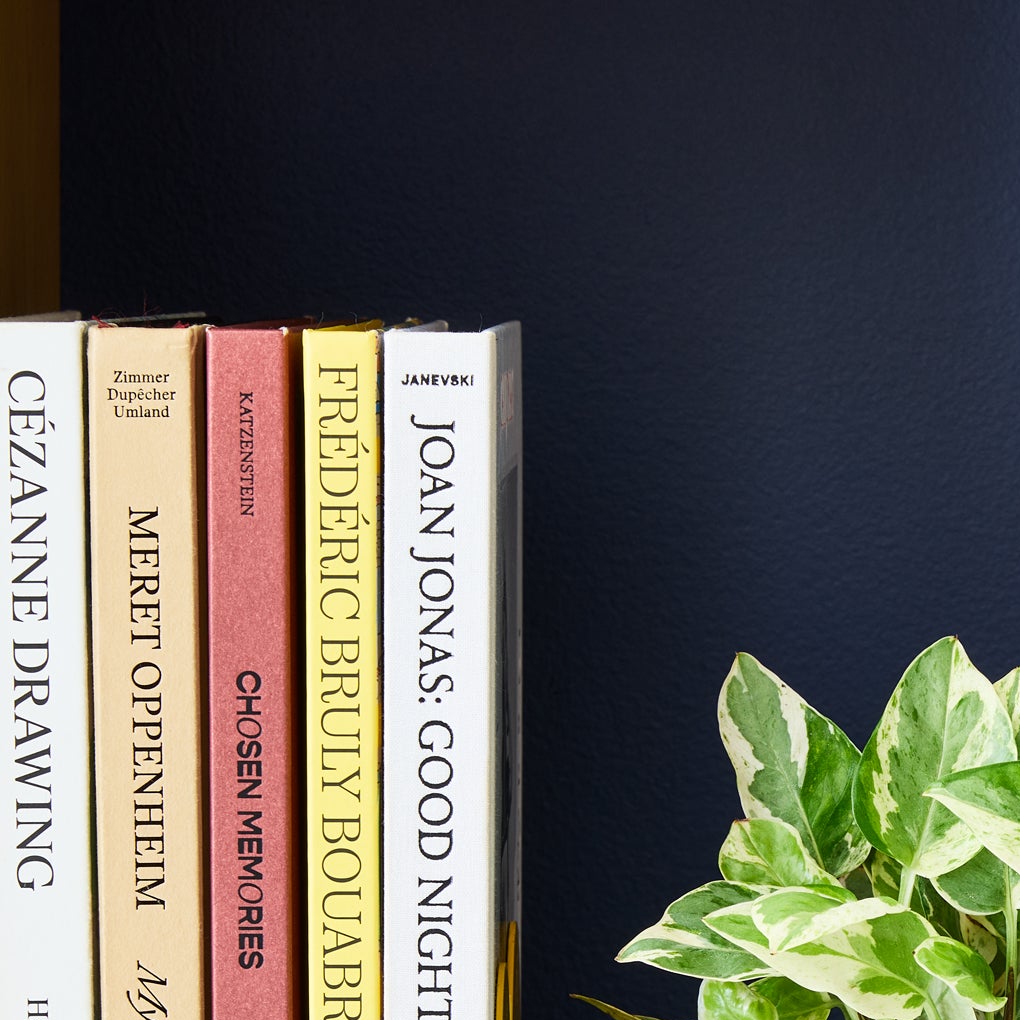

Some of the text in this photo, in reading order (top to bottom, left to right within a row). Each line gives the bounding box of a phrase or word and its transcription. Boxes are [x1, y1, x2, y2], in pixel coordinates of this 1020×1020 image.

[107, 388, 176, 403] Dupêcher
[114, 371, 169, 383] Zimmer
[114, 405, 169, 417] Umland
[401, 374, 474, 386] JANEVSKI
[240, 392, 254, 517] KATZENSTEIN
[319, 364, 370, 619] FRÉDÉRIC
[411, 414, 455, 537] JOAN
[8, 371, 55, 891] CÉZANNE DRAWING
[410, 547, 454, 703] JONAS:
[129, 507, 165, 910] MERET OPPENHEIM
[321, 636, 360, 802] BRULY
[236, 671, 264, 969] CHOSEN MEMORIES
[418, 720, 453, 860] GOOD
